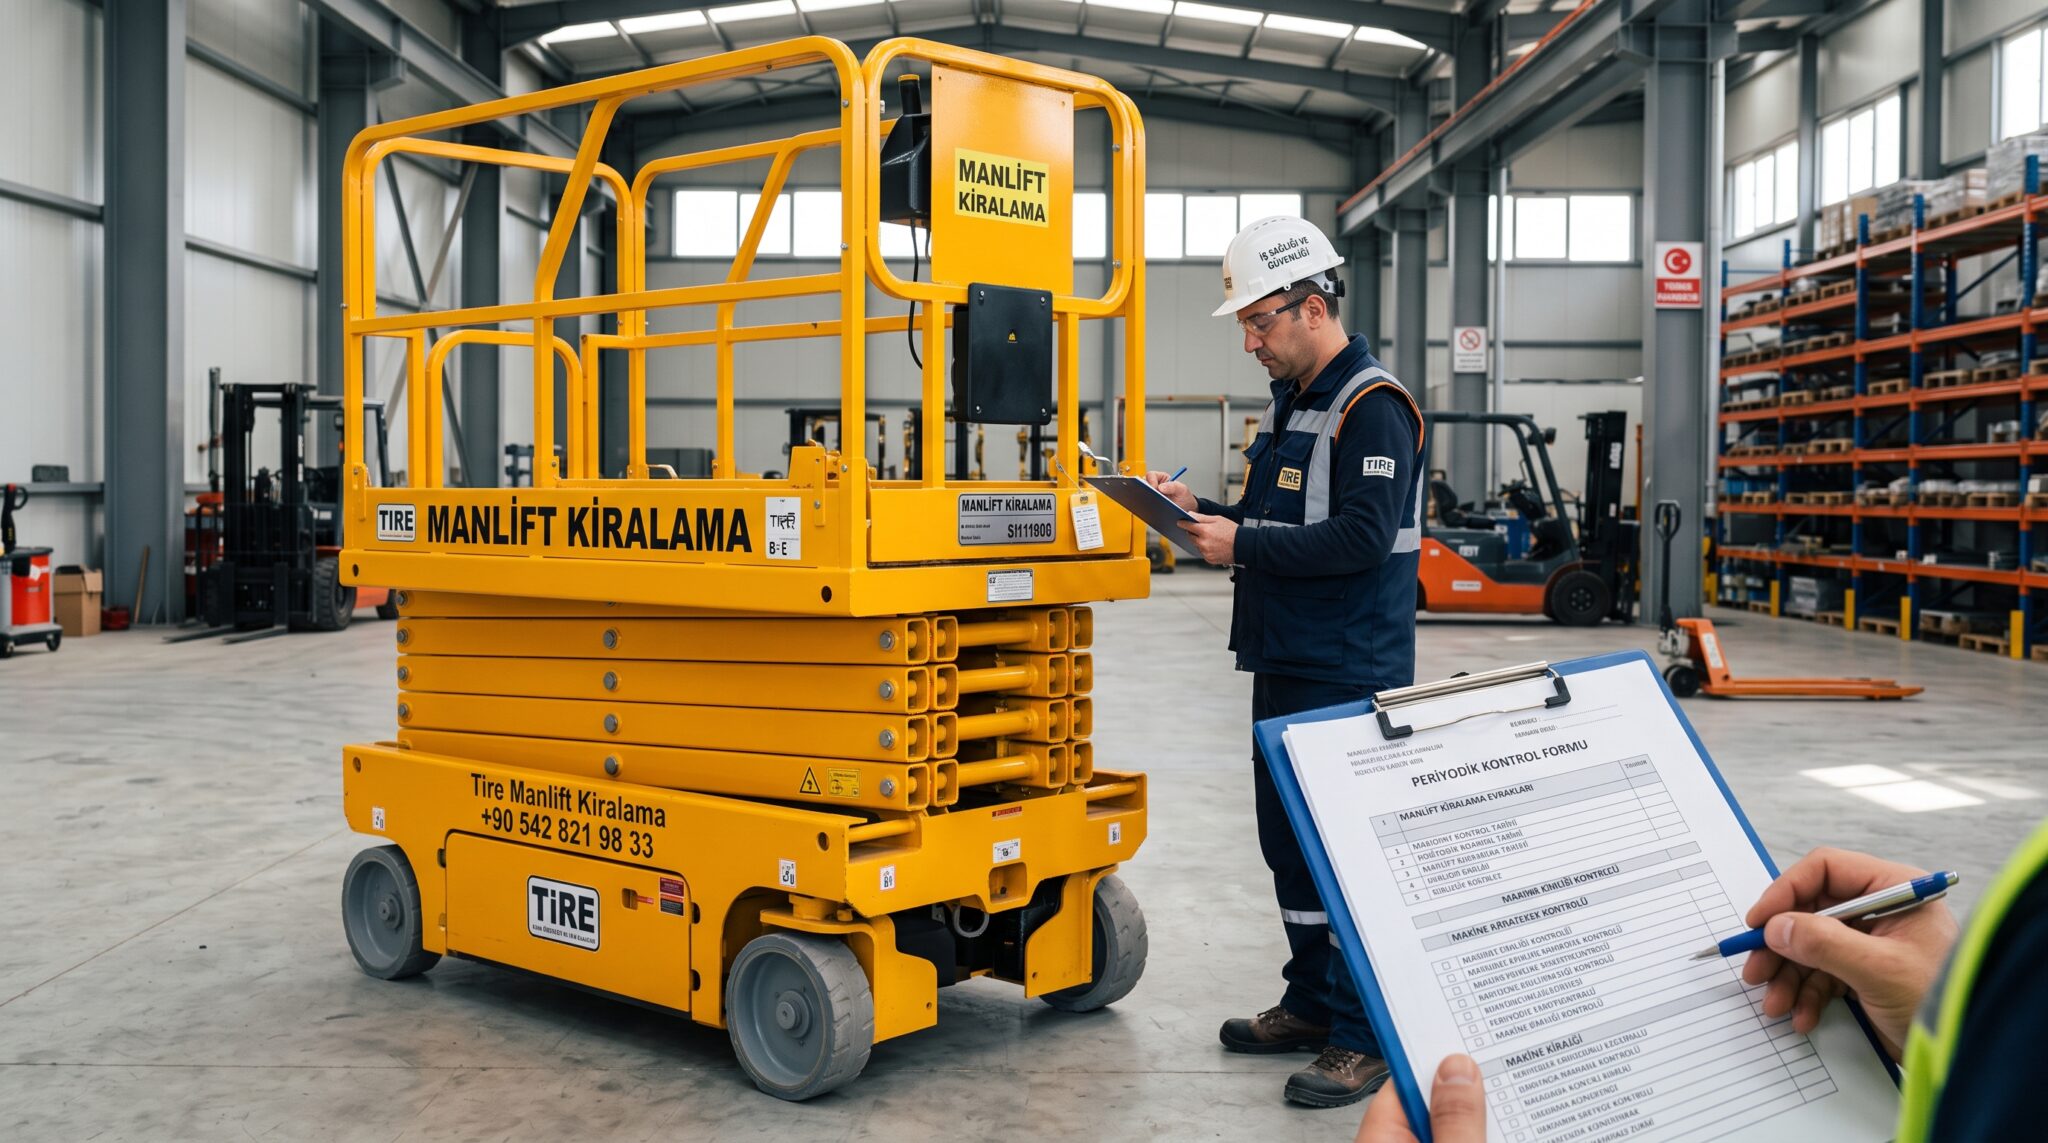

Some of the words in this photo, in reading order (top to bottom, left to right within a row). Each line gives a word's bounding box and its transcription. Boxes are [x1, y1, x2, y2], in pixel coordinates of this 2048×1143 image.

[959, 159, 1046, 194] MANLİFT
[958, 188, 1046, 222] KİRALAMA
[1267, 247, 1310, 270] GÜVENLİĞİ
[1268, 238, 1299, 257] SAĞLIĞI
[1298, 236, 1309, 245] VE
[1280, 469, 1300, 485] TIRE
[1365, 459, 1394, 473] TIRE
[961, 497, 1003, 512] MANLİFT
[1005, 496, 1052, 511] KİRALAMA
[379, 510, 414, 532] TIRE
[427, 496, 557, 547] MANLİFT
[567, 496, 753, 553] KİRALAMA
[1411, 762, 1480, 788] PERİYODİK
[1481, 750, 1542, 773] KONTROL
[1542, 739, 1589, 759] FORMU
[471, 772, 504, 801] Tire
[510, 779, 572, 813] Manlift
[577, 789, 666, 828] Kiralama
[1399, 805, 1439, 822] MANLİFT
[1441, 792, 1487, 812] KİRALAMA
[1487, 783, 1535, 802] EVRAKLARI
[481, 807, 514, 833] +90
[519, 812, 552, 840] 542
[558, 818, 591, 847] 821
[599, 825, 623, 853] 98
[629, 830, 654, 859] 33
[1451, 924, 1490, 942] MAKİNE
[1541, 896, 1589, 917] KONTROLÜ
[1505, 1050, 1546, 1068] MAKİNE
